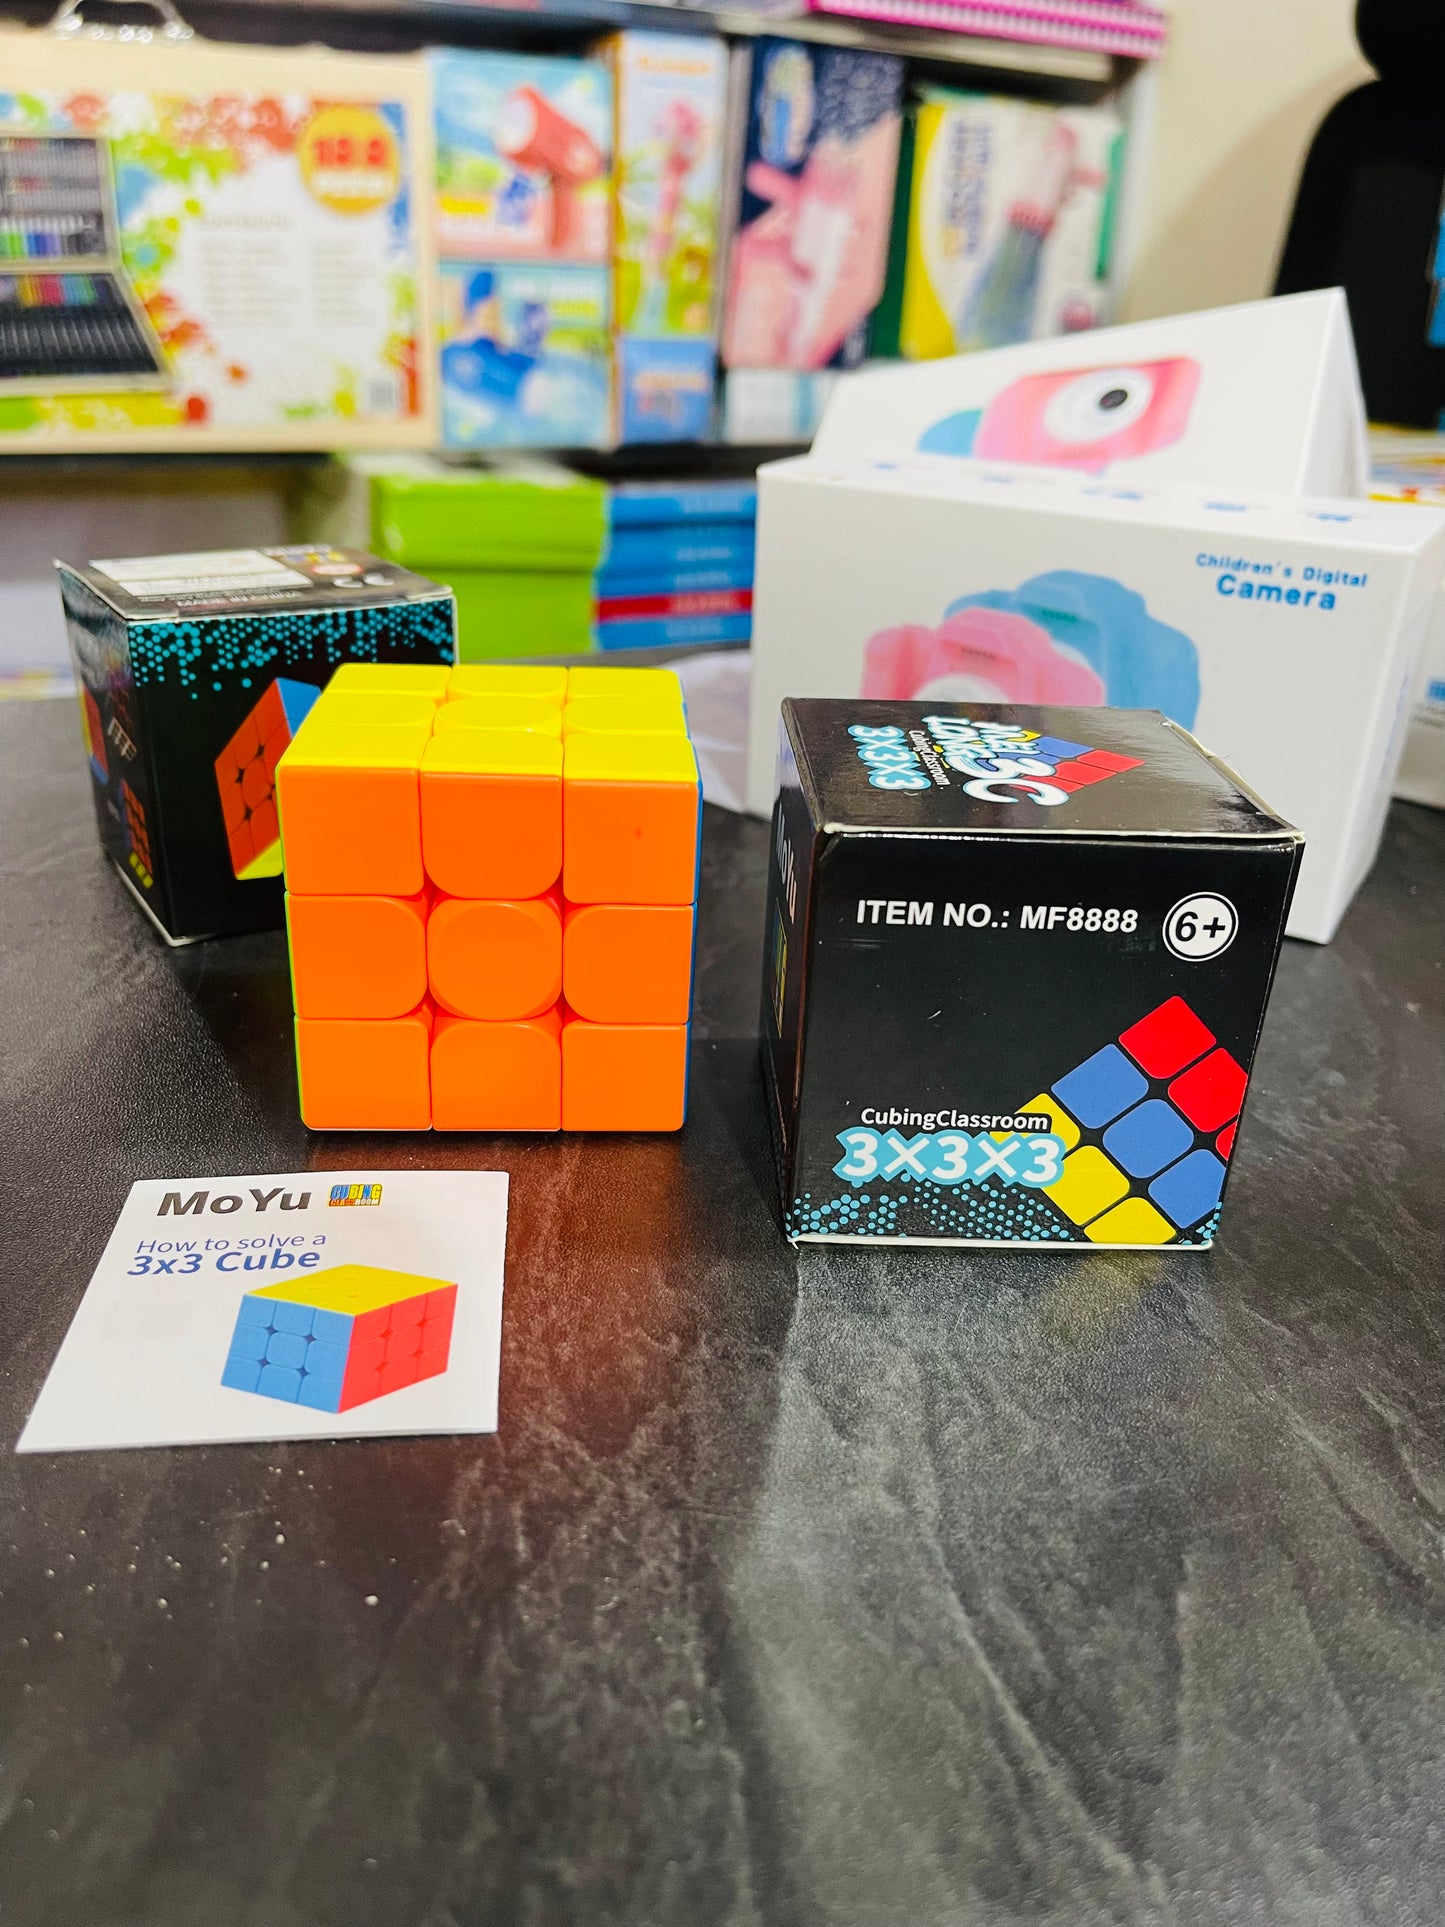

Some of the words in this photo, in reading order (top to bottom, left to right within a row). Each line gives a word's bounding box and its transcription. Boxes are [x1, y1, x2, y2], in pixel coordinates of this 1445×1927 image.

[1196, 553, 1292, 578] Children's
[1303, 566, 1367, 587] Digital
[1217, 573, 1336, 610] Camera
[908, 729, 950, 787] CubingClassroom
[776, 803, 797, 925] MoYu
[856, 899, 934, 926] ITEM
[943, 902, 1010, 929] NO.:
[1019, 905, 1139, 933] MF8888
[1174, 911, 1226, 942] 6+
[861, 1107, 1048, 1131] CubingClassroom
[157, 1187, 312, 1216] MoYu
[330, 1184, 383, 1199] CUBING
[137, 1240, 198, 1254] How
[205, 1238, 229, 1251] to
[237, 1234, 305, 1250] solve
[312, 1234, 327, 1246] a
[127, 1253, 203, 1276] 3x3
[216, 1249, 321, 1272] Cube
